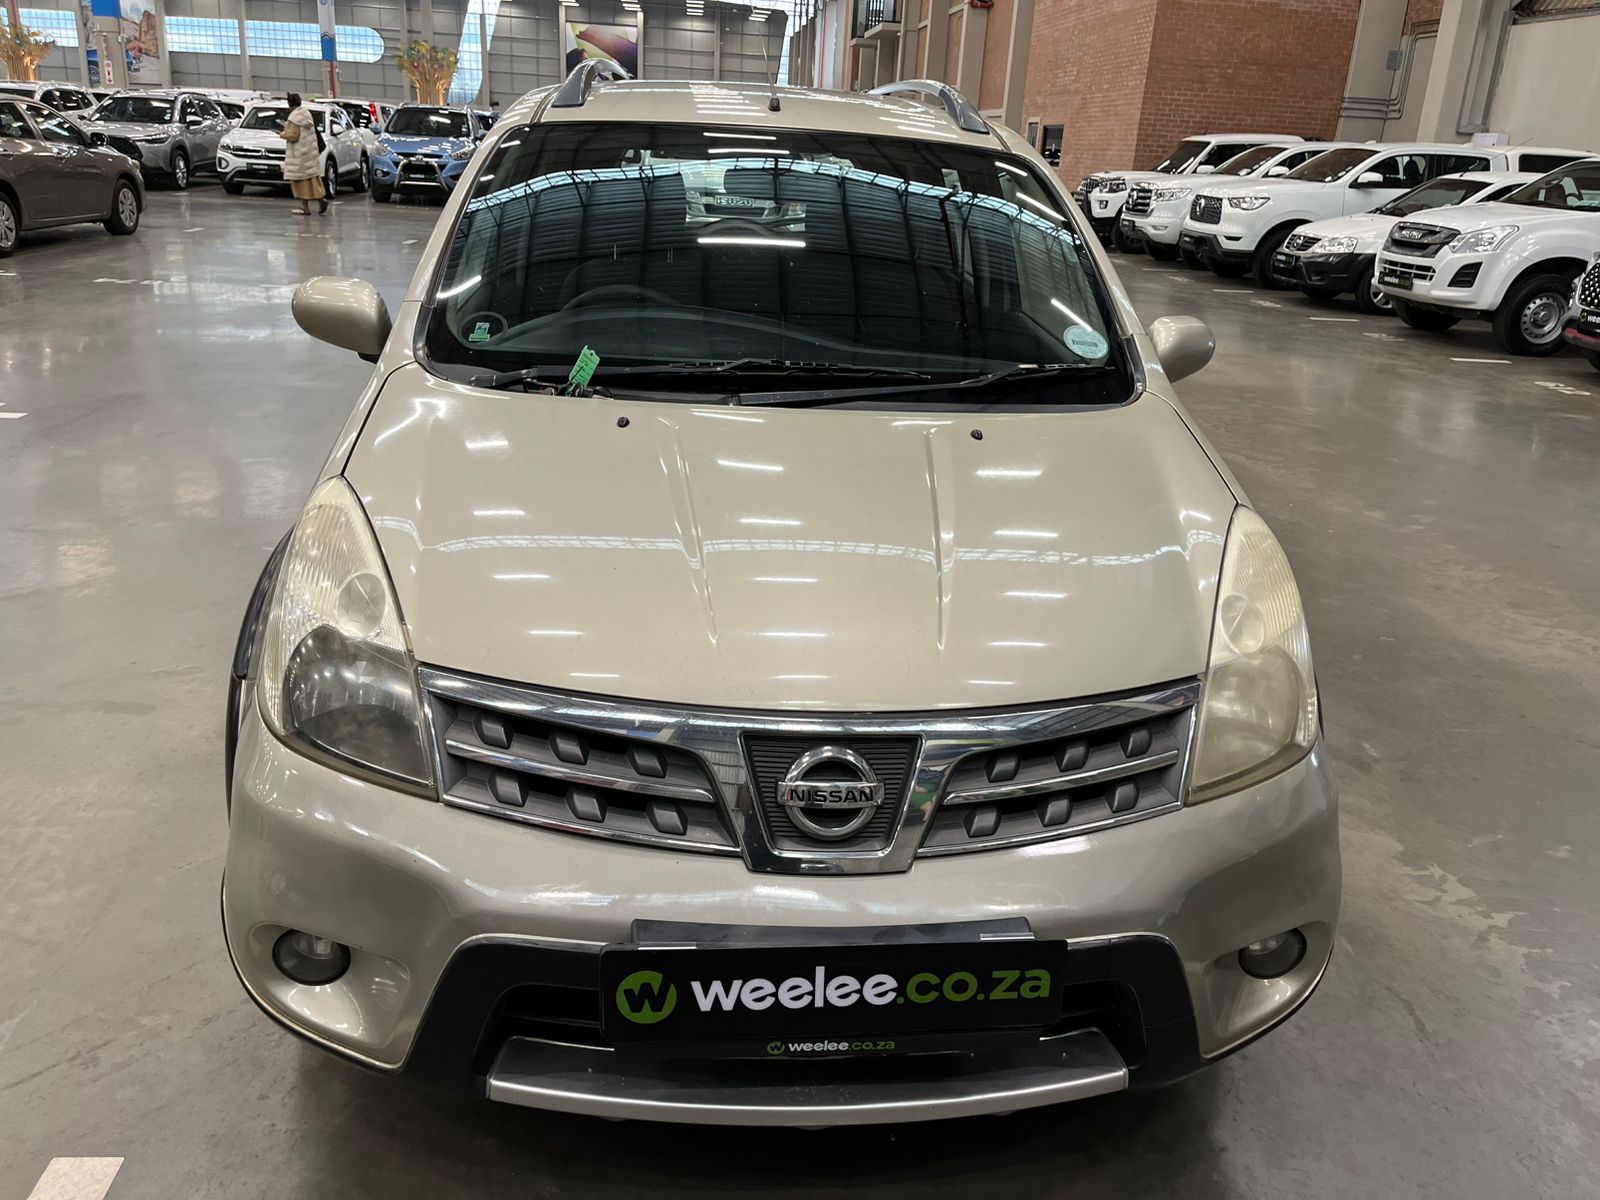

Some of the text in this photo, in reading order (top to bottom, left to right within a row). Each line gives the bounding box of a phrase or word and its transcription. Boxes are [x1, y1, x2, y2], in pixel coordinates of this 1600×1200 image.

[717, 197, 753, 206] ISUZU
[789, 788, 874, 804] NISSAN
[690, 966, 1051, 1012] weelee.co.za
[788, 1040, 895, 1052] weelee.co.za
